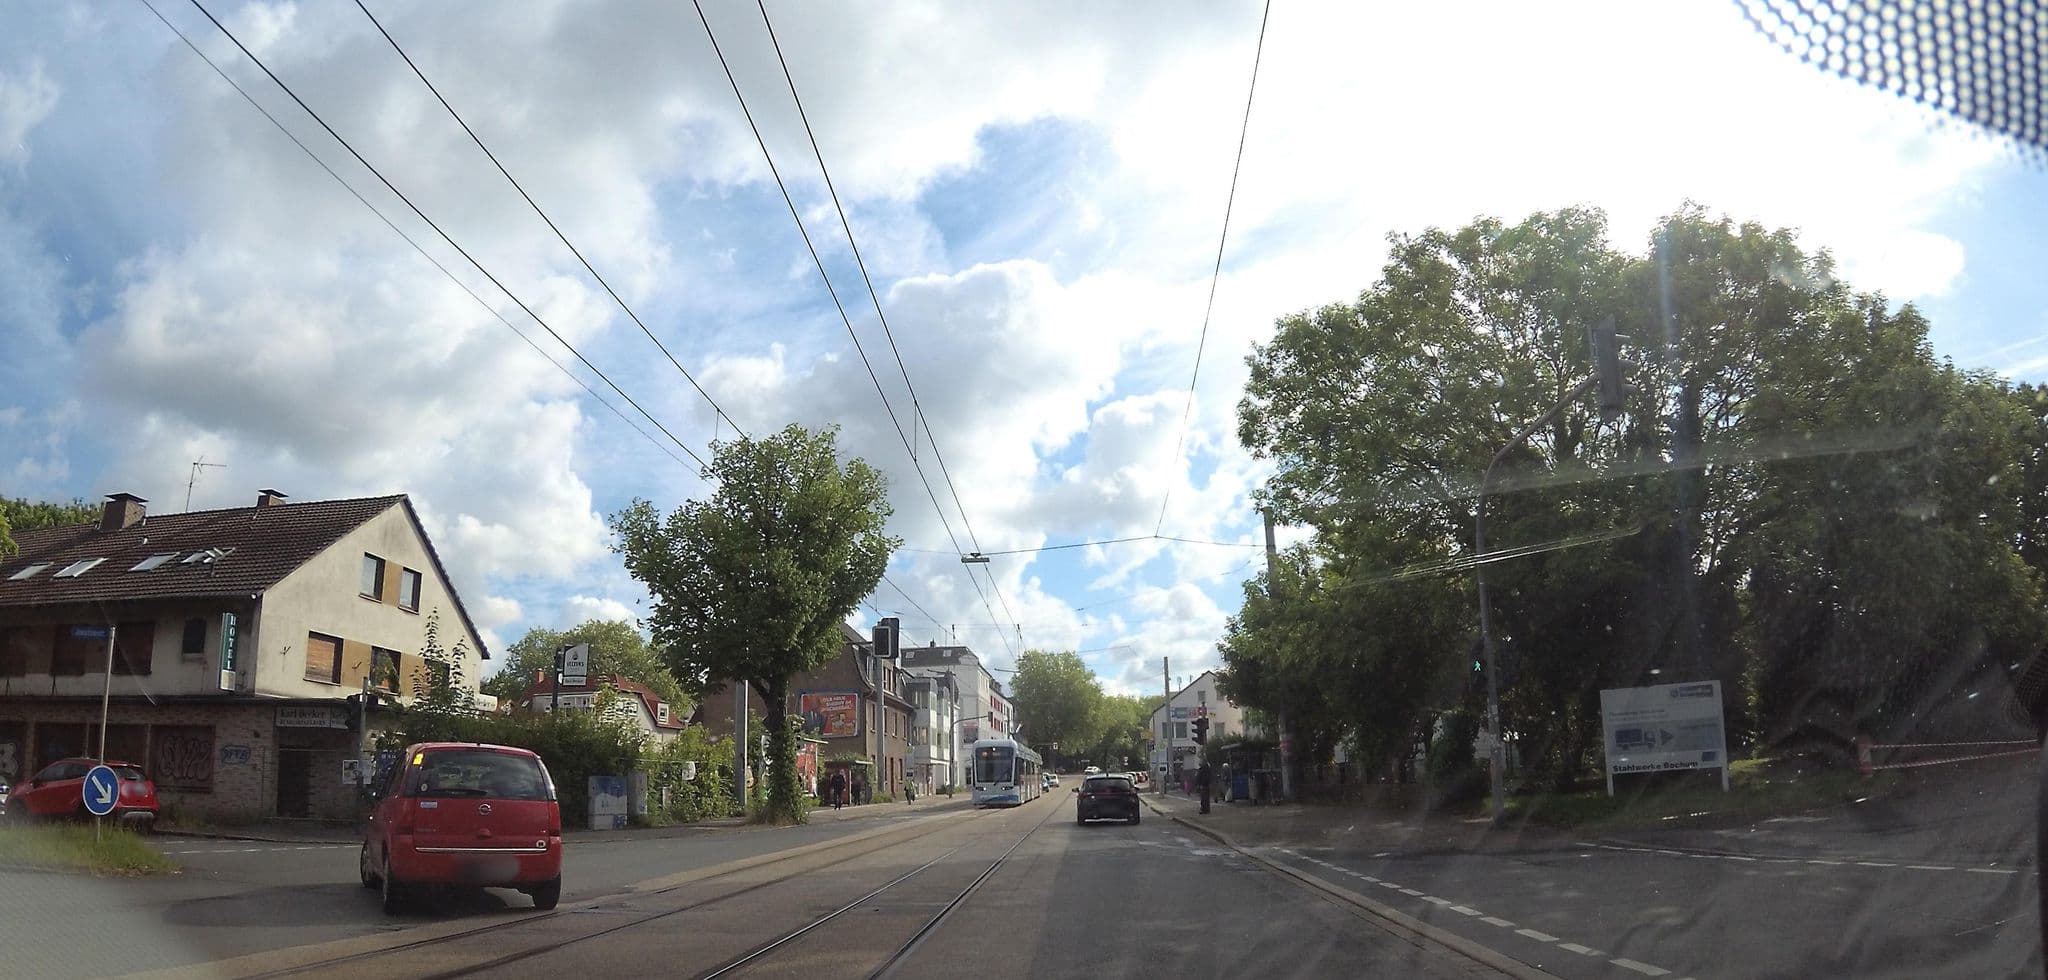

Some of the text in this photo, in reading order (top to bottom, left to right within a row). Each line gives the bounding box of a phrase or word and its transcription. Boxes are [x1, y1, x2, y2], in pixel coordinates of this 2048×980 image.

[226, 615, 236, 670] HOTEL
[1612, 761, 1698, 772] Stahlwerke Bochum
